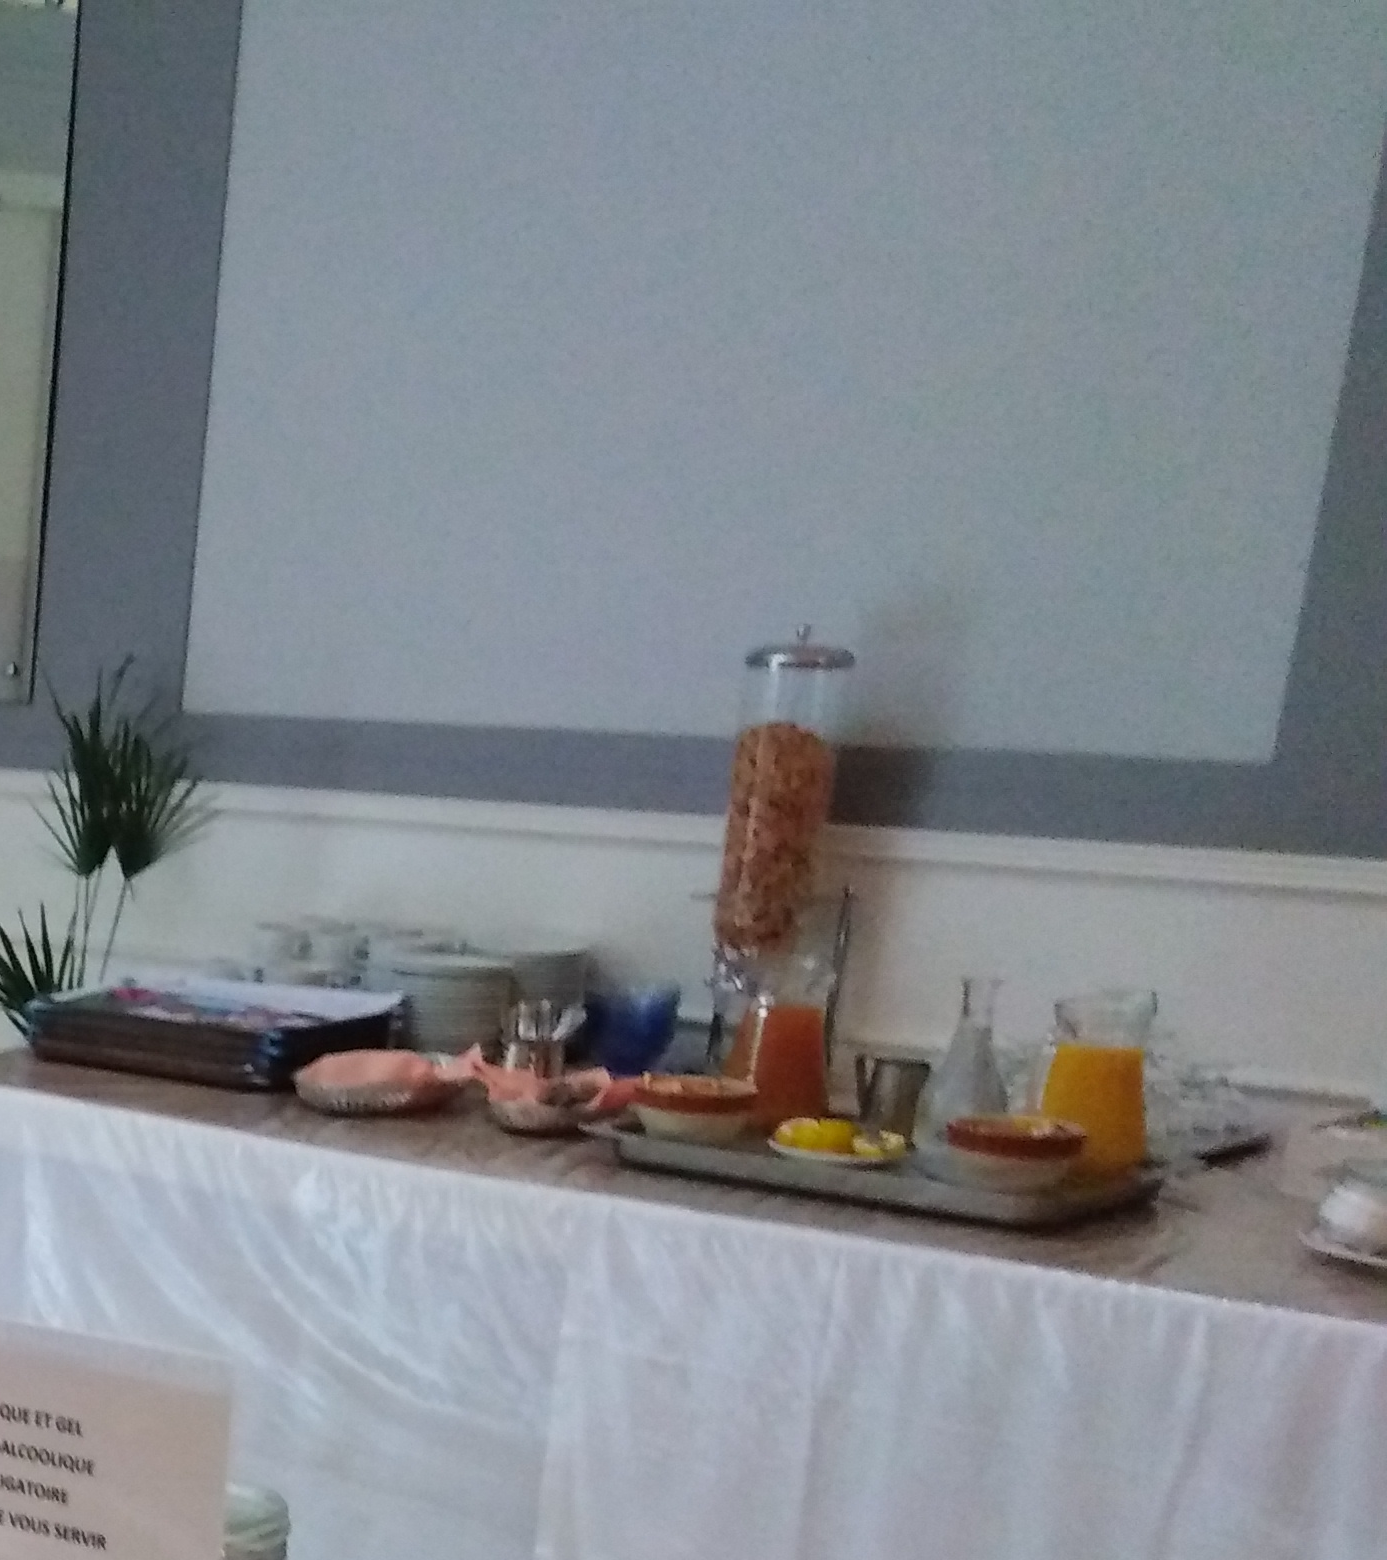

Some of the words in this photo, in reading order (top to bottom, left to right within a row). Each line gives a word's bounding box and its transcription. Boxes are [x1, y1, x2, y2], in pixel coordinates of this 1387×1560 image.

[34, 1409, 52, 1428] ET
[55, 1415, 83, 1437] GEL
[8, 1511, 50, 1536] VOUS
[54, 1522, 107, 1550] SERVIR
